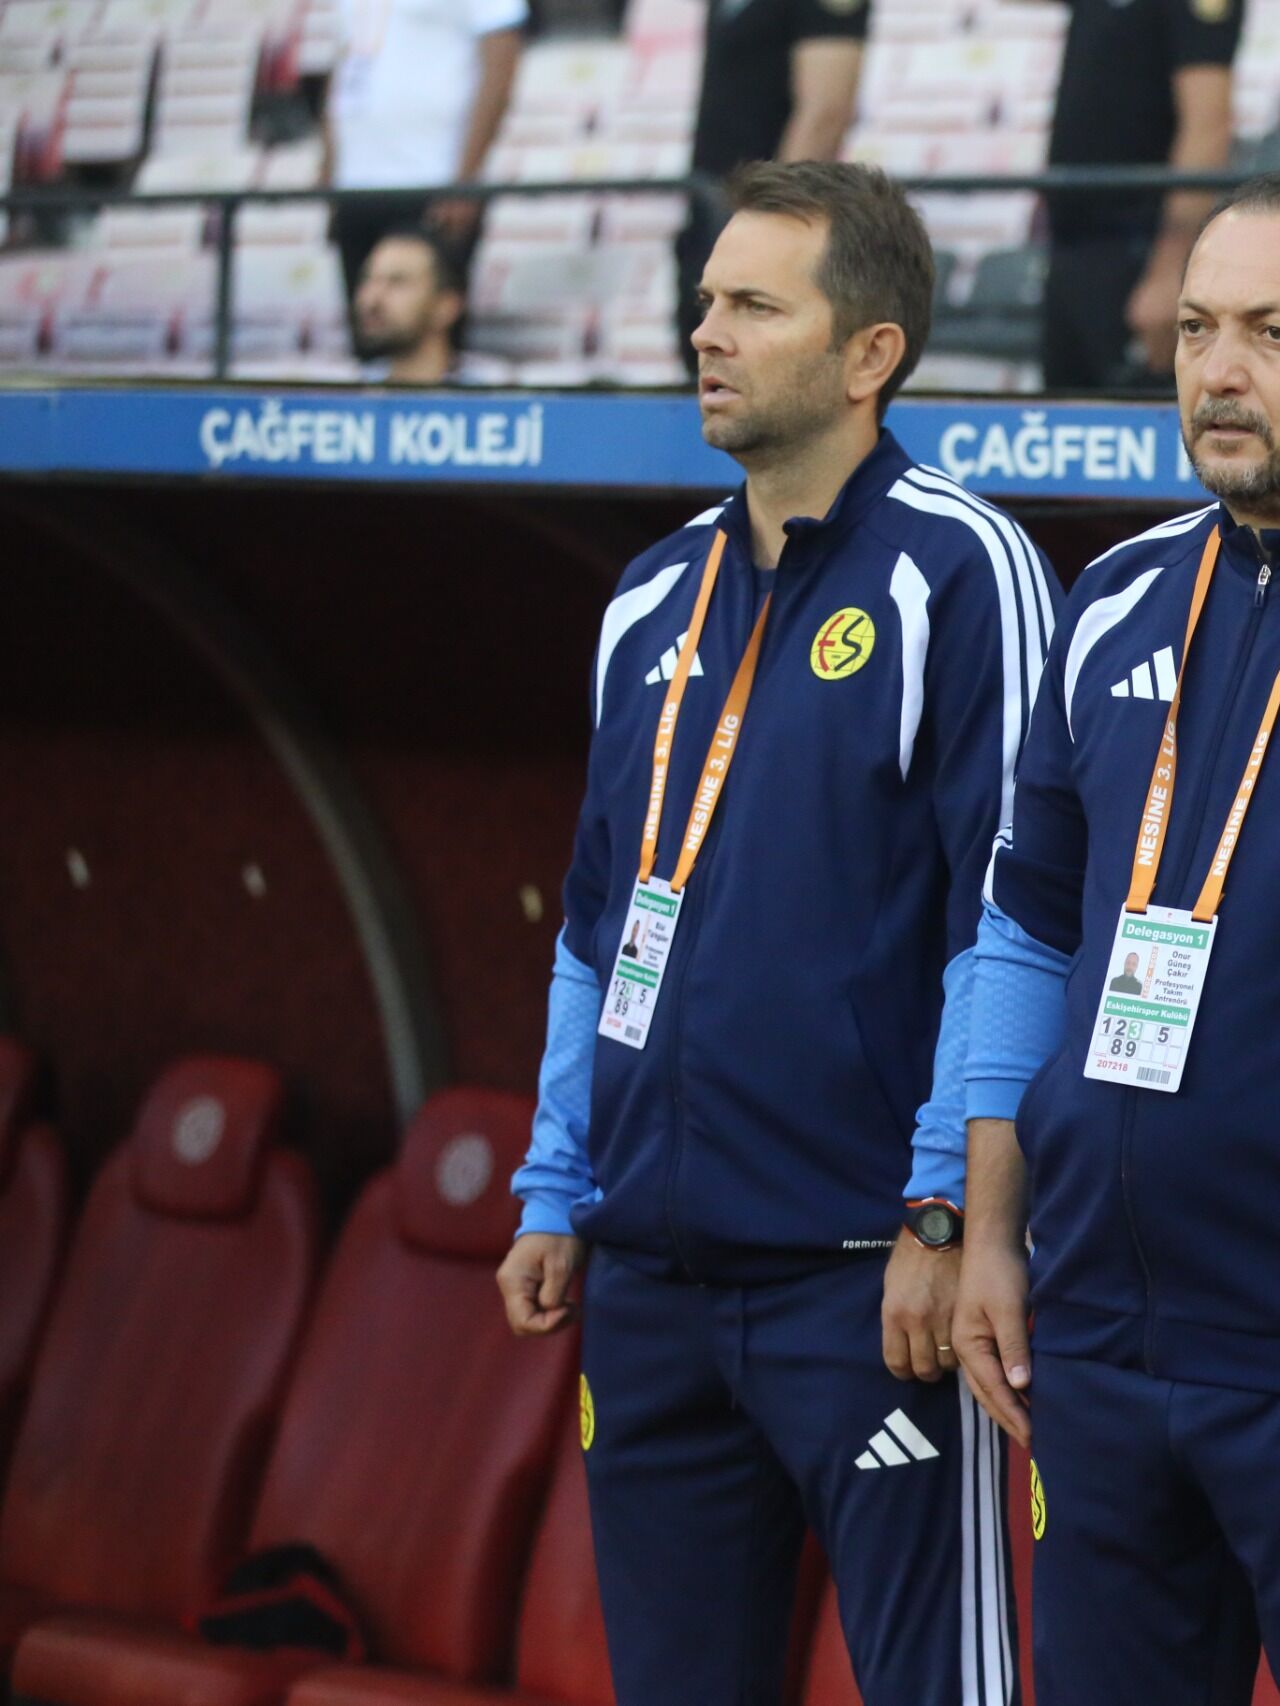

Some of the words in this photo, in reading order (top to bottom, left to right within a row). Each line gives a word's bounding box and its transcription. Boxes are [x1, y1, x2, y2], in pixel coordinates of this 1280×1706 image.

[201, 398, 375, 469] ÇAĞFEN
[389, 402, 544, 467] KOLEJİ
[940, 410, 1156, 485] ÇAĞFEN
[686, 775, 720, 850] NESİNE
[716, 714, 740, 749] LİG
[1137, 784, 1168, 866] NESİNE
[1163, 722, 1176, 757] LİG
[1212, 796, 1247, 876] NESİNE
[1251, 731, 1268, 766] LİG
[1126, 923, 1194, 944] Delegasyon
[1197, 934, 1204, 945] 1
[1167, 959, 1192, 971] Güneş
[1172, 950, 1192, 960] Onur
[1167, 968, 1189, 978] Çakır
[1155, 978, 1194, 991] Profesyonel
[1163, 987, 1183, 996] Takım
[1106, 1001, 1160, 1016] Eskişehirspor
[1160, 1009, 1188, 1021] Kulübü
[1157, 1026, 1170, 1043] 5
